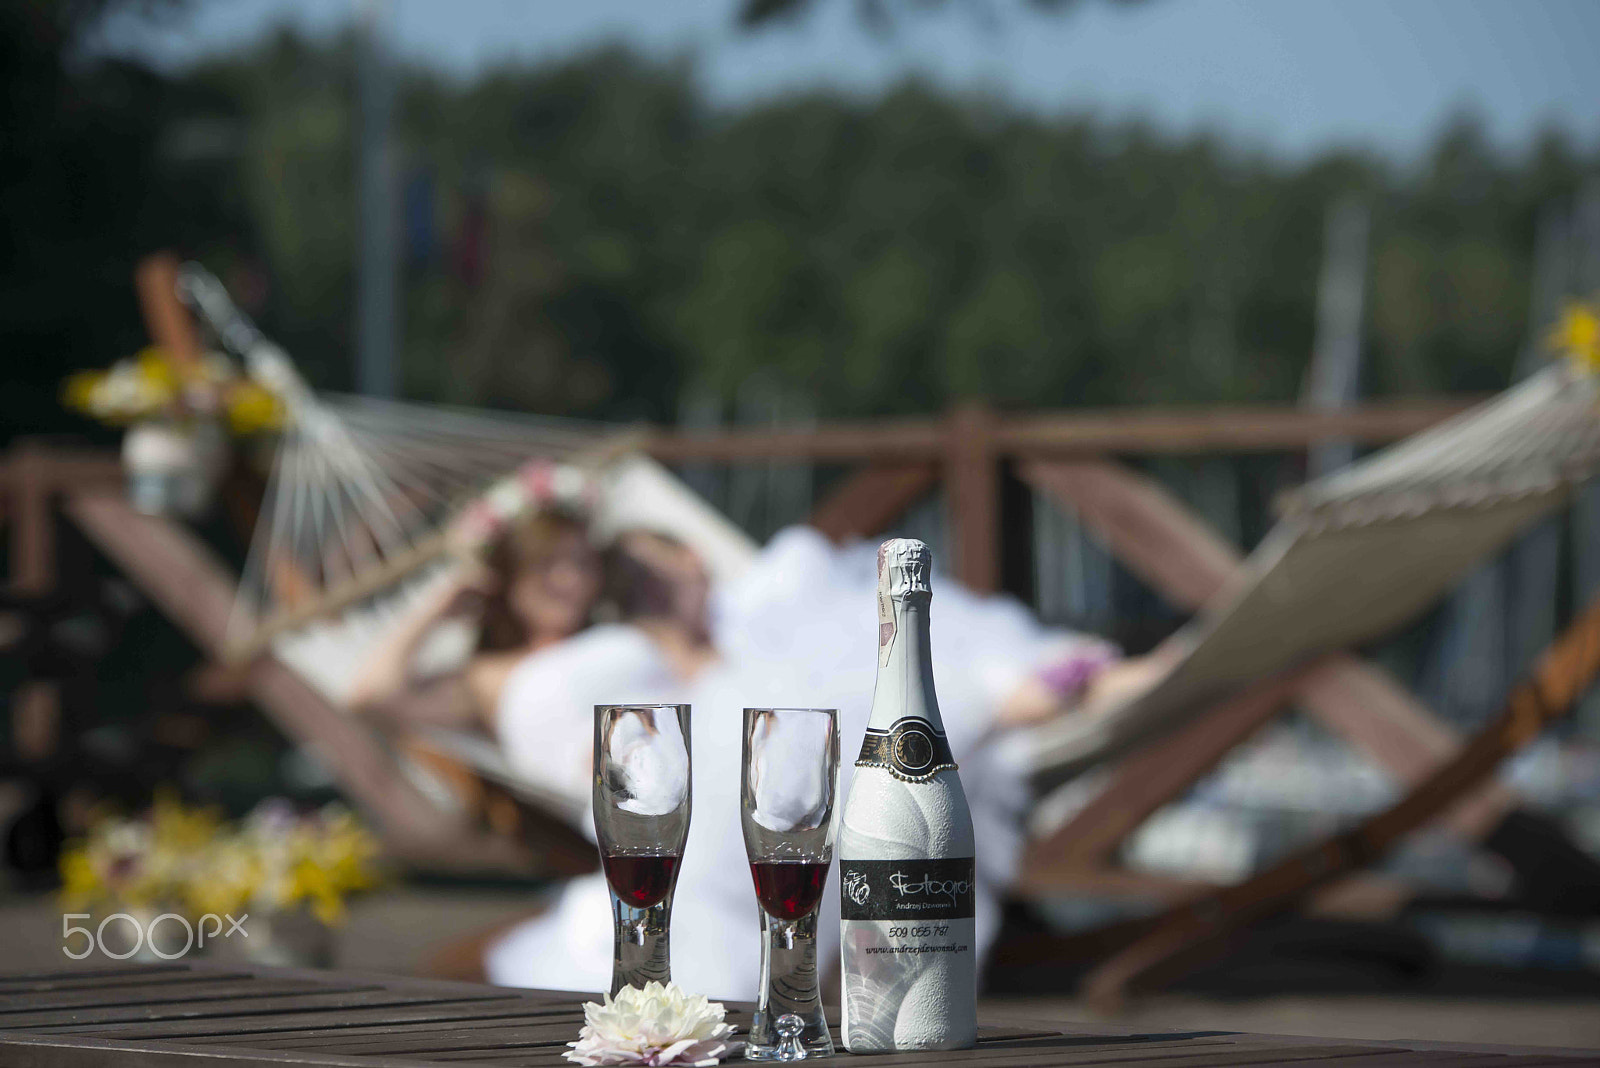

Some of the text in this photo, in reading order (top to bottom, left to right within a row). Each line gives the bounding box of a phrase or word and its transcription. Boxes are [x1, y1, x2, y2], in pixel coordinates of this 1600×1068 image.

[896, 902, 922, 911] Andrzej
[888, 926, 908, 938] 509
[911, 926, 931, 938] 055
